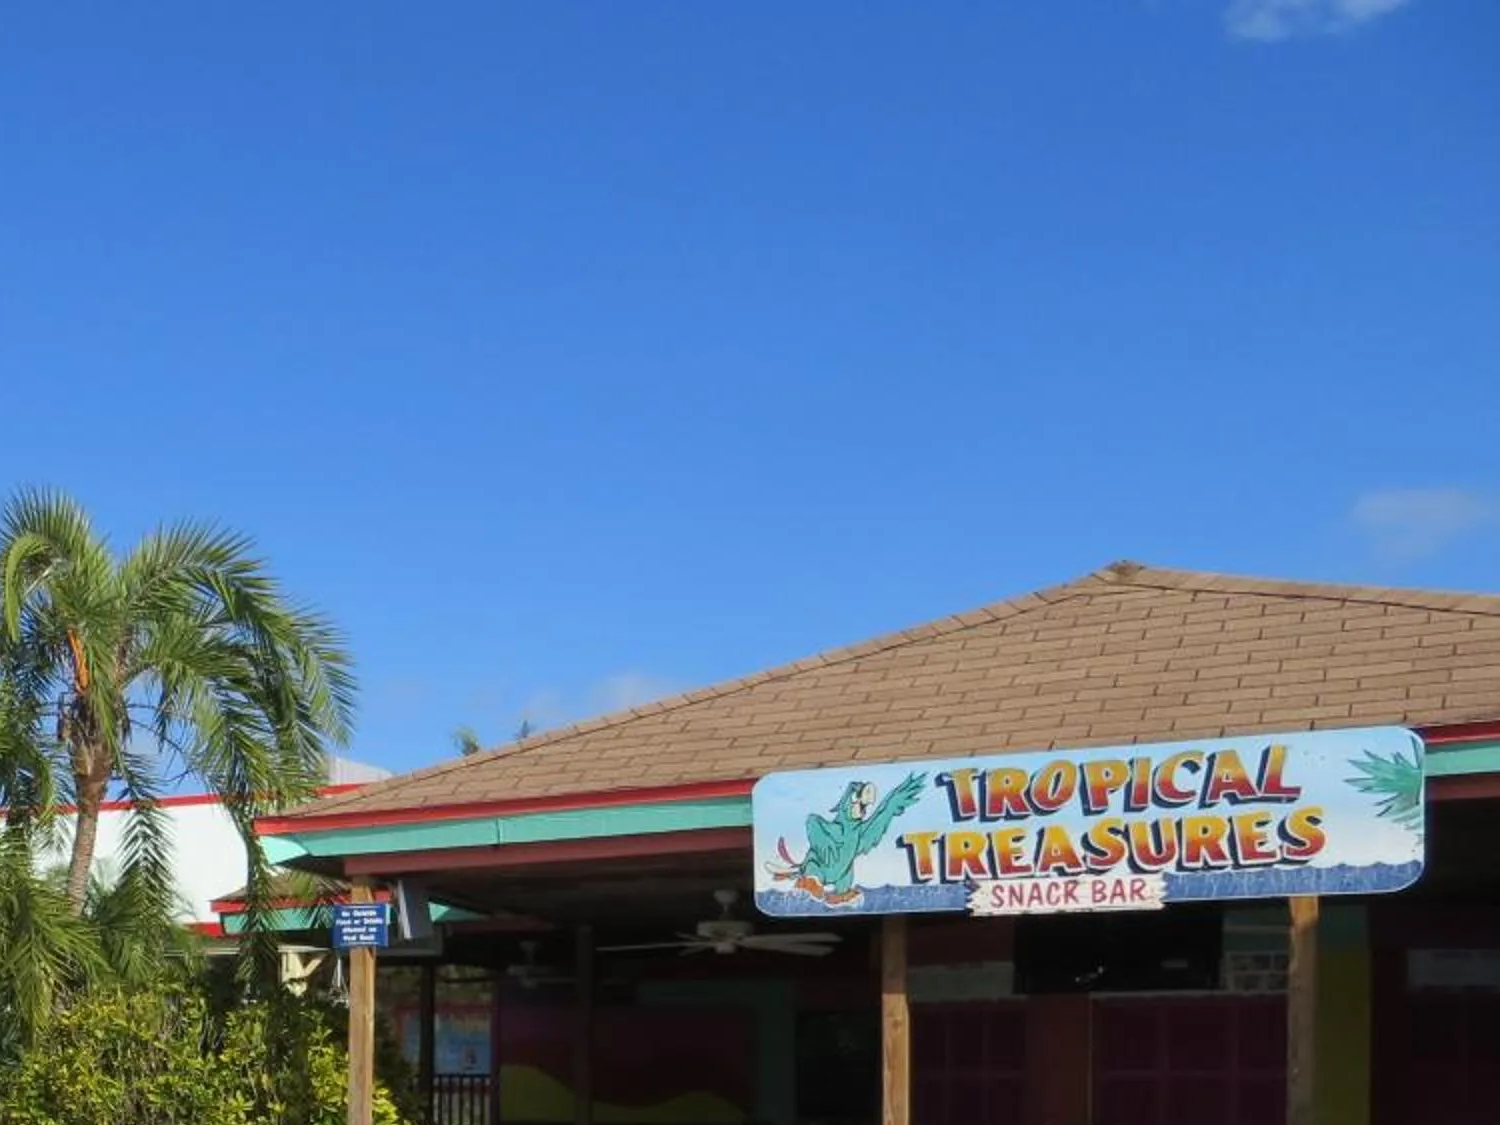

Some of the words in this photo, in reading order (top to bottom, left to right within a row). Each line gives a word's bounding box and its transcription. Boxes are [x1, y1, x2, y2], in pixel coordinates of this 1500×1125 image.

[936, 745, 1302, 822] TROPICAL
[896, 805, 1327, 881] TREASURES
[990, 878, 1081, 909] SNACK
[1091, 876, 1148, 903] BAR
